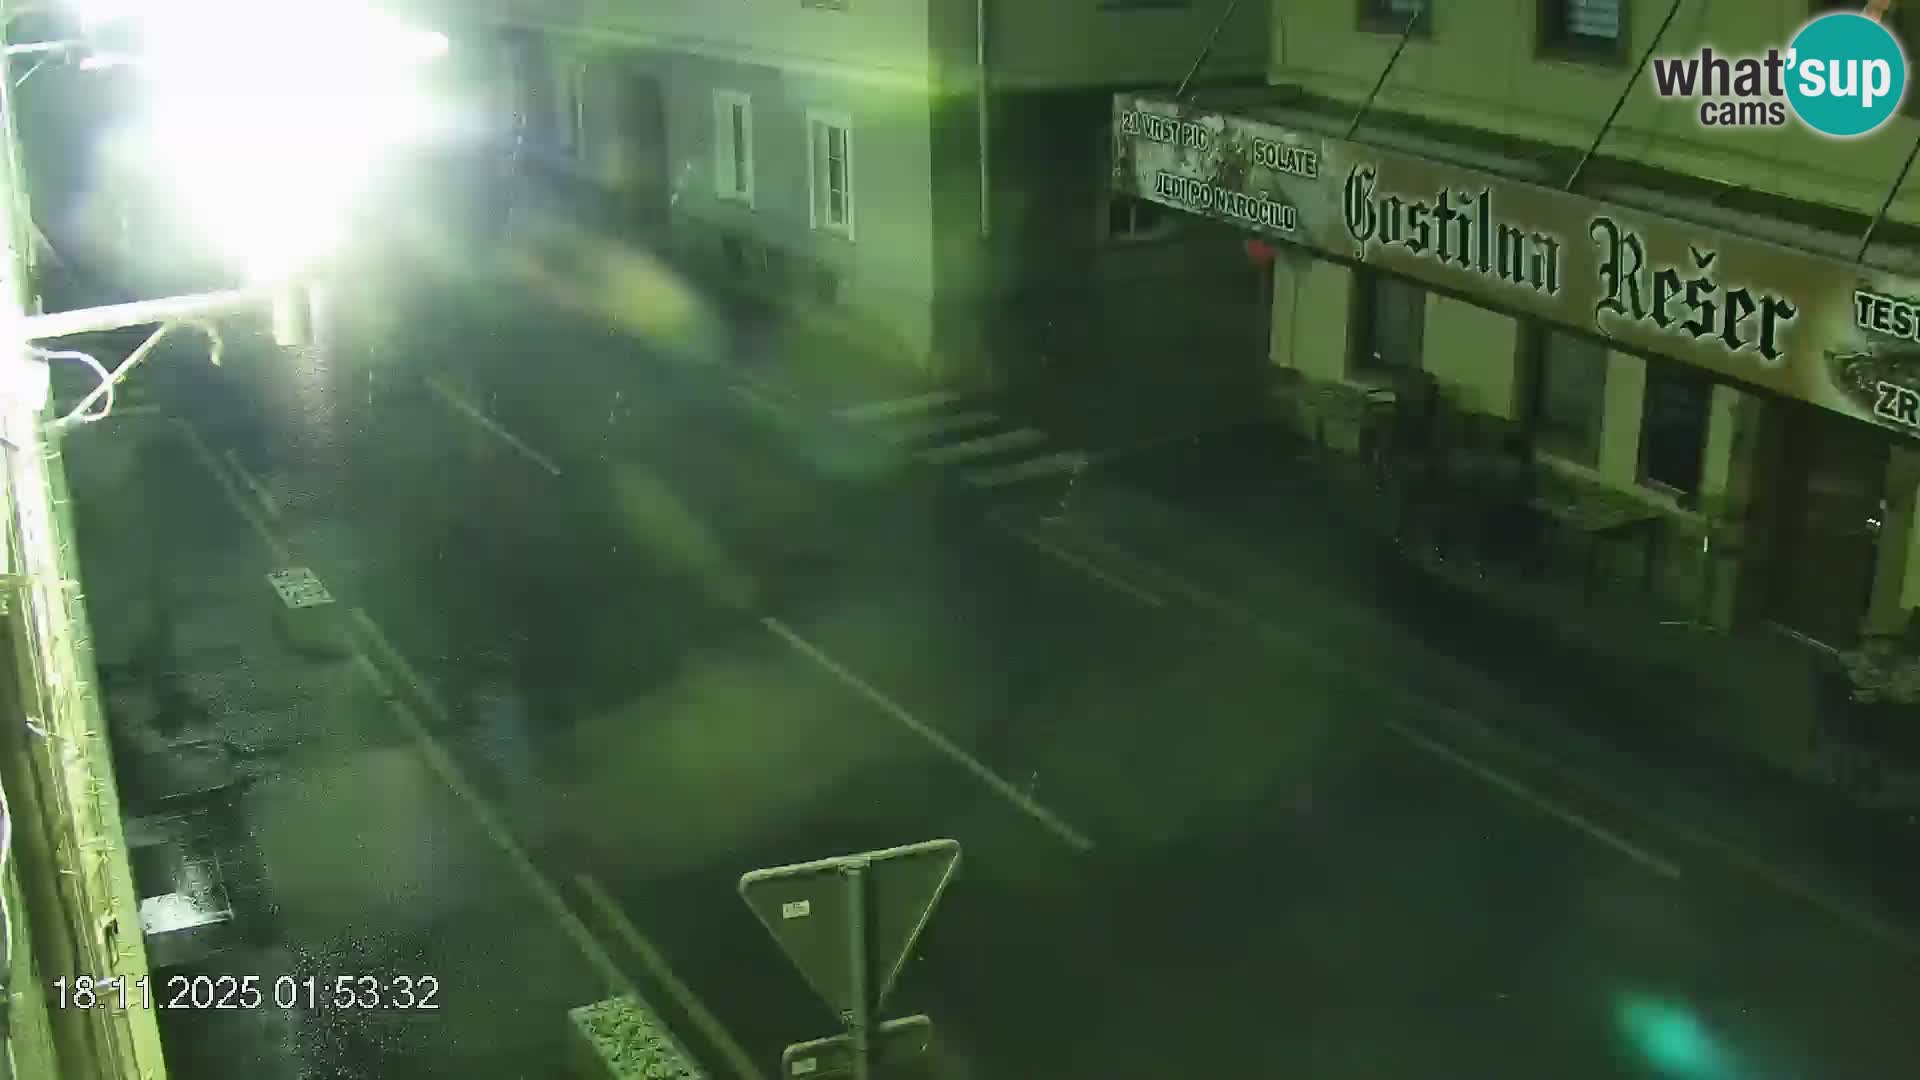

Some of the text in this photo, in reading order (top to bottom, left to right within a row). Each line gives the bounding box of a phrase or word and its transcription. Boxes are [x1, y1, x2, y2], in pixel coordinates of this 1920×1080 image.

[1254, 138, 1318, 179] SOLATE
[1156, 172, 1297, 232] JEDI PO NAROČILU
[1343, 163, 1798, 361] Gostilna Rešer
